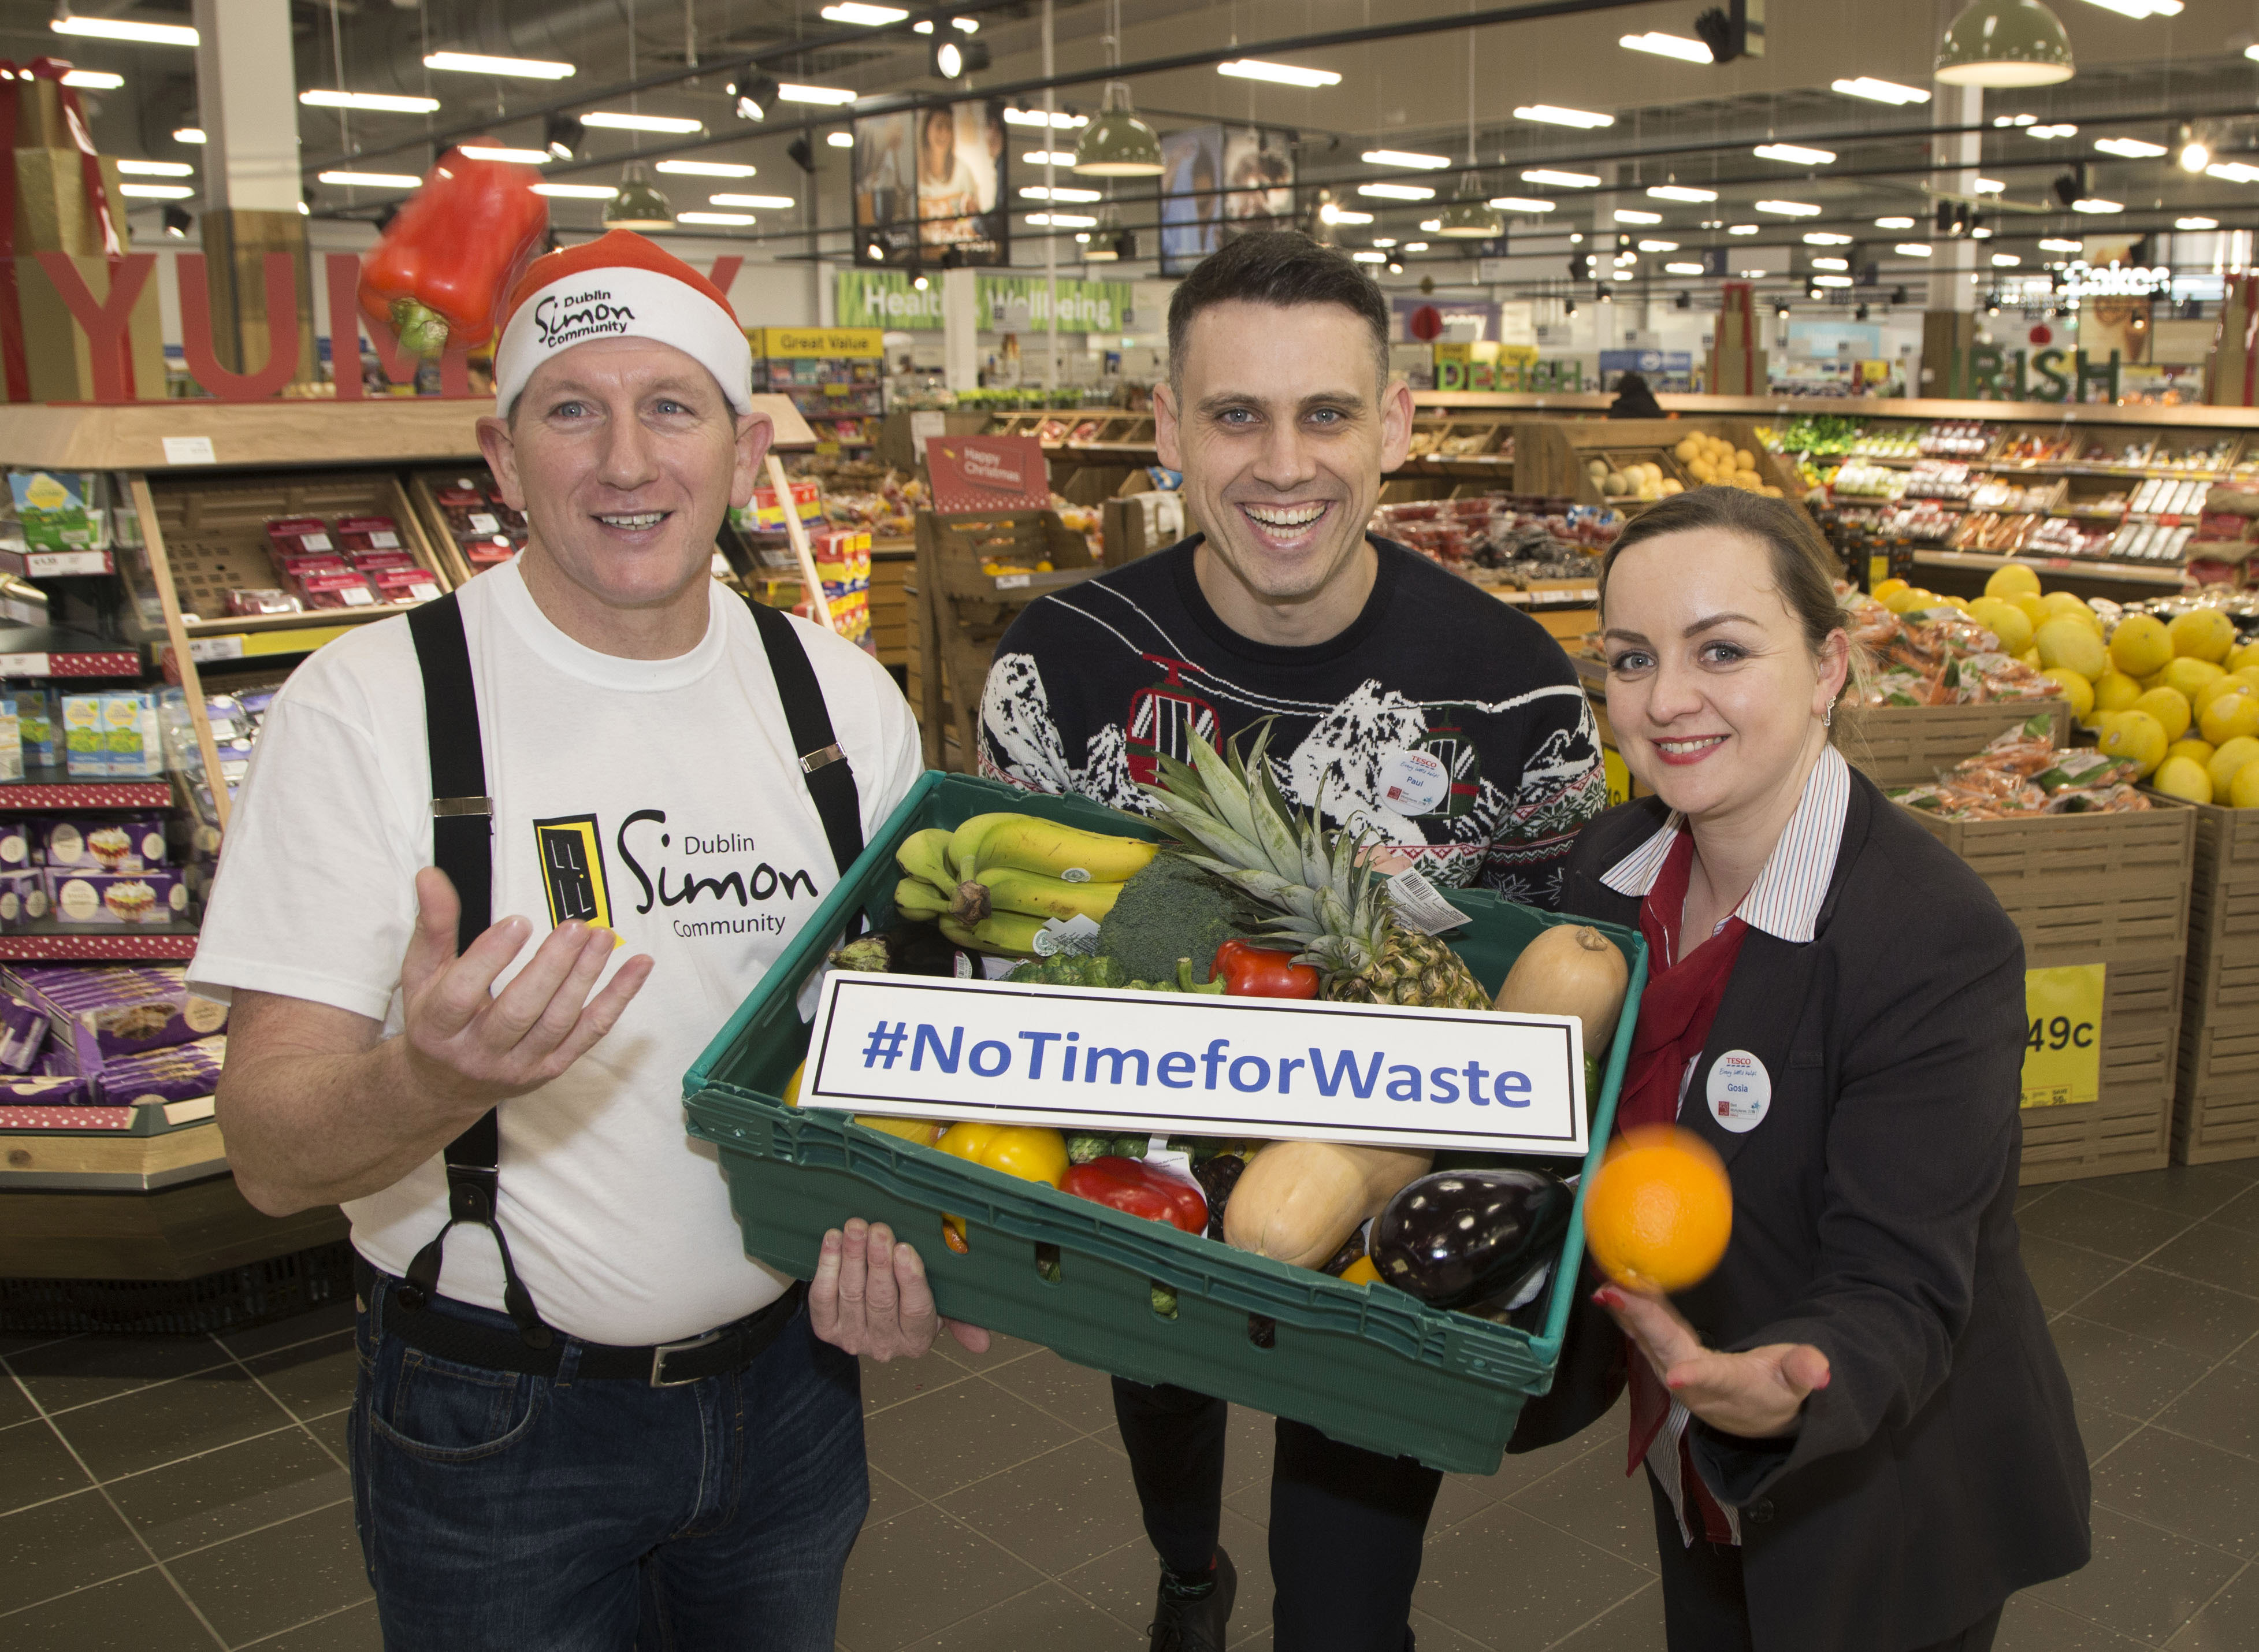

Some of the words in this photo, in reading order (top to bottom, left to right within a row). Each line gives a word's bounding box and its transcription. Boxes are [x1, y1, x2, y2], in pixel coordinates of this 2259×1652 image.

[564, 290, 611, 307] Dublin
[867, 285, 944, 317] Healt
[535, 296, 636, 343] Simon
[548, 320, 627, 348] Community
[781, 333, 824, 351] Great
[827, 333, 872, 350] Value
[1437, 358, 1582, 393] DELISH
[1949, 347, 2120, 403] IRISH
[964, 446, 1002, 468] Happy
[964, 461, 1021, 482] Christmas
[1411, 755, 1437, 768] TESCO
[1406, 776, 1424, 787] Paul
[685, 833, 755, 855] Dublin
[617, 809, 818, 914] Simon
[673, 913, 786, 937] Community
[862, 1020, 1533, 1109] #NoTimeforWaste
[1727, 1083, 1748, 1093] Gosia
